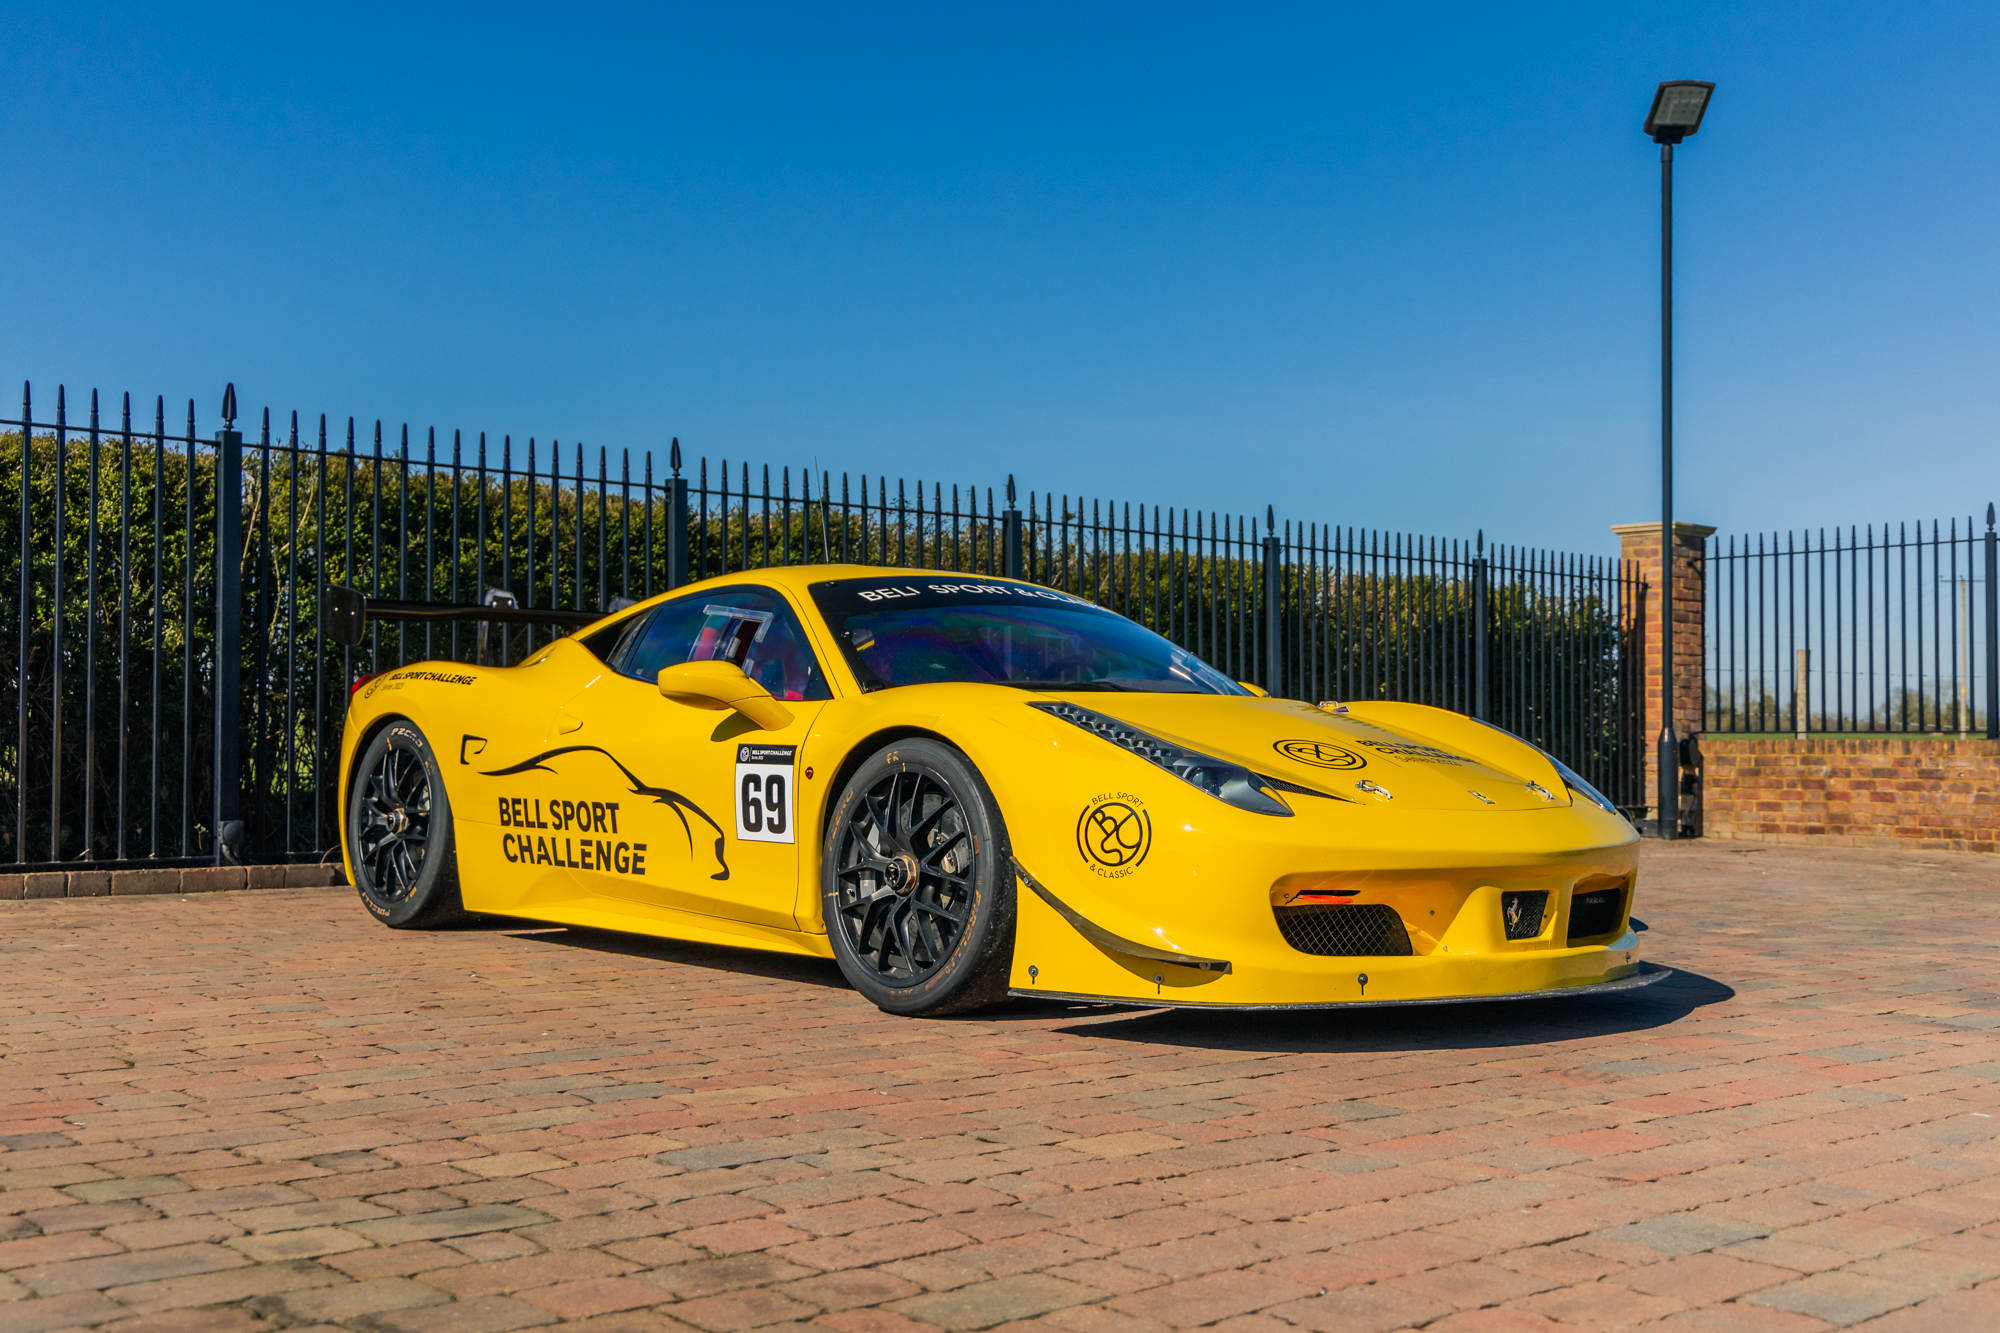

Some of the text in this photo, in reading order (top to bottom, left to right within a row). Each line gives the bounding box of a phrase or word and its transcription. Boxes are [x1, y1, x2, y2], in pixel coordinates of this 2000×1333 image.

[927, 584, 1012, 595] SPORT
[1013, 588, 1039, 598] &
[424, 672, 478, 686] CHALLENGE
[742, 773, 786, 835] 69
[1092, 791, 1144, 808] BELL SPORT
[498, 797, 619, 834] BELL SPORT
[503, 833, 647, 875] CHALLENGE
[1089, 863, 1134, 879] & CLASSIC
